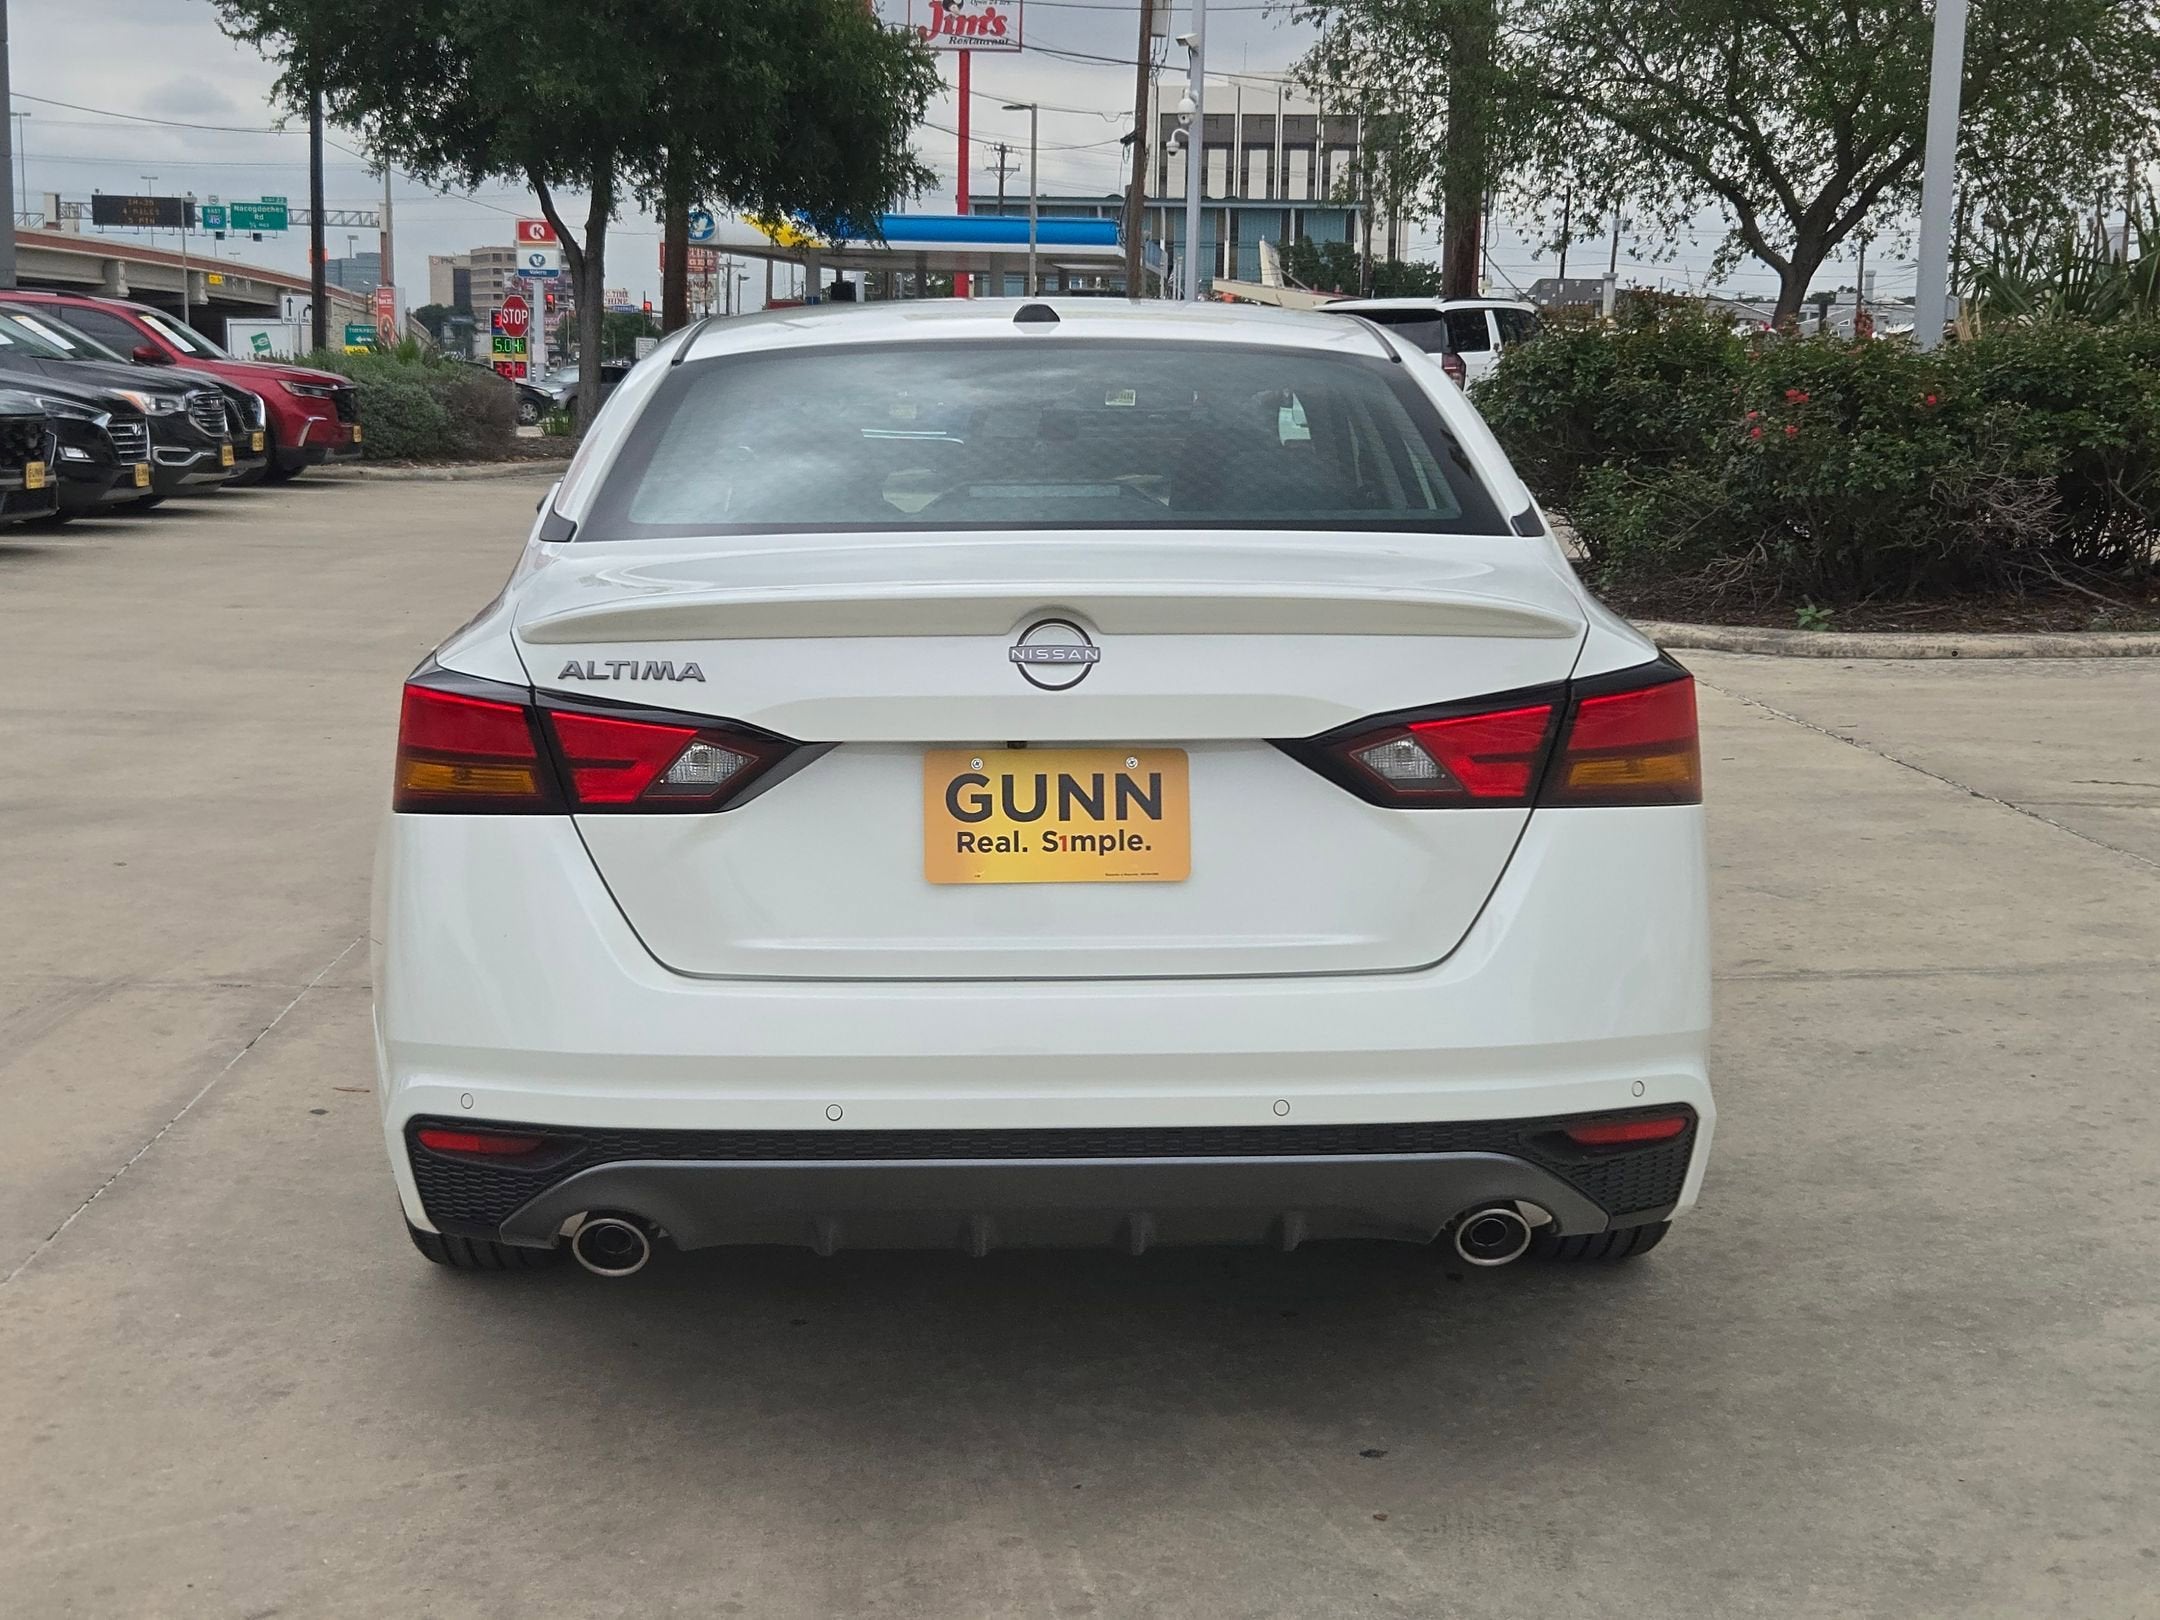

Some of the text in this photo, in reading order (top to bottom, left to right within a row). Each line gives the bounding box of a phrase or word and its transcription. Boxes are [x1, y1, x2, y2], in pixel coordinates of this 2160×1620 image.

[917, 0, 1008, 42] Jim's
[949, 35, 1009, 46] Restaurant
[233, 205, 284, 214] Nacogdoches
[502, 308, 528, 325] STOP
[1011, 648, 1099, 661] NISSAN
[558, 660, 706, 682] ALTIMA
[945, 772, 1162, 823] GUNN
[957, 828, 1152, 856] Real. S1mple.
